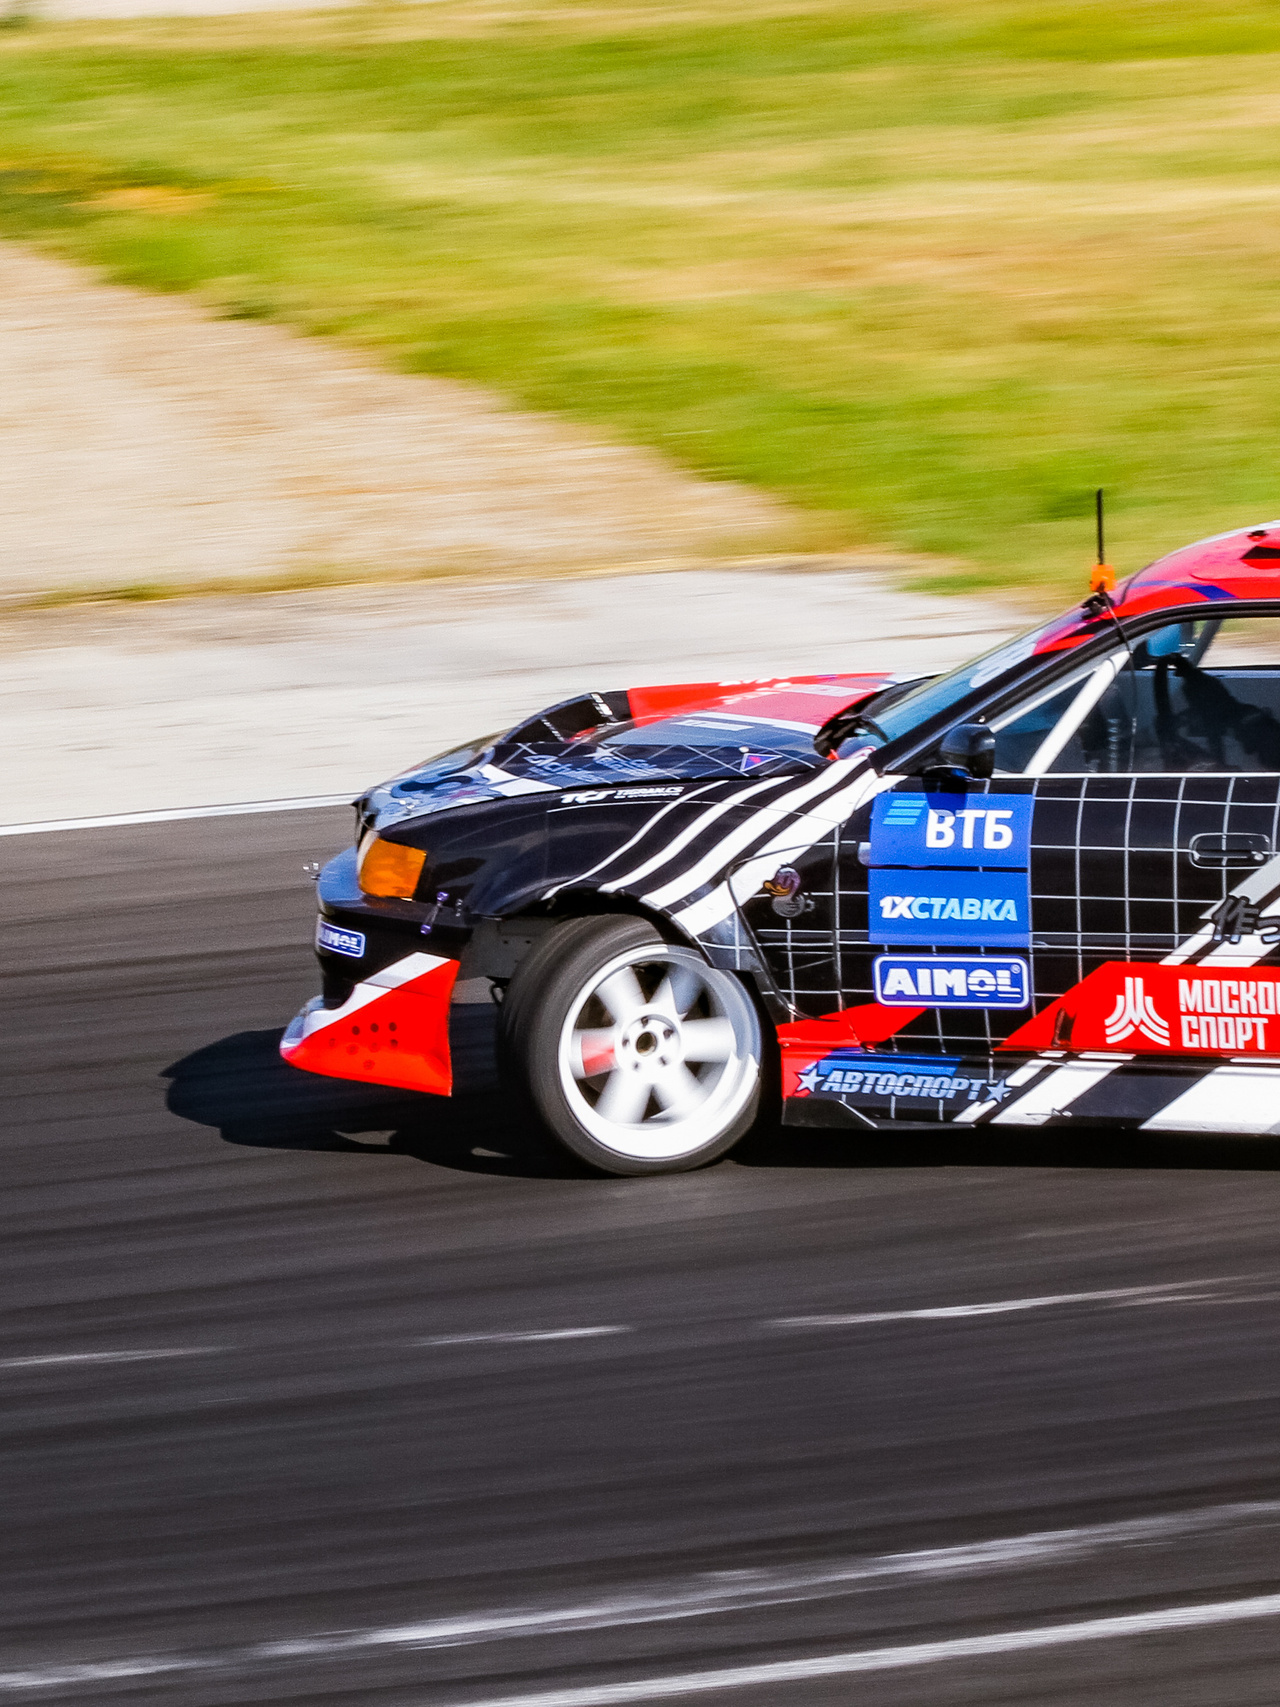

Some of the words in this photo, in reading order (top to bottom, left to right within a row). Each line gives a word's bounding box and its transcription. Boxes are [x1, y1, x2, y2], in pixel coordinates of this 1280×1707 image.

[926, 809, 1014, 850] ВТБ
[1181, 1015, 1269, 1051] СПОРТ
[820, 1070, 988, 1101] АВТОСПОРТ
